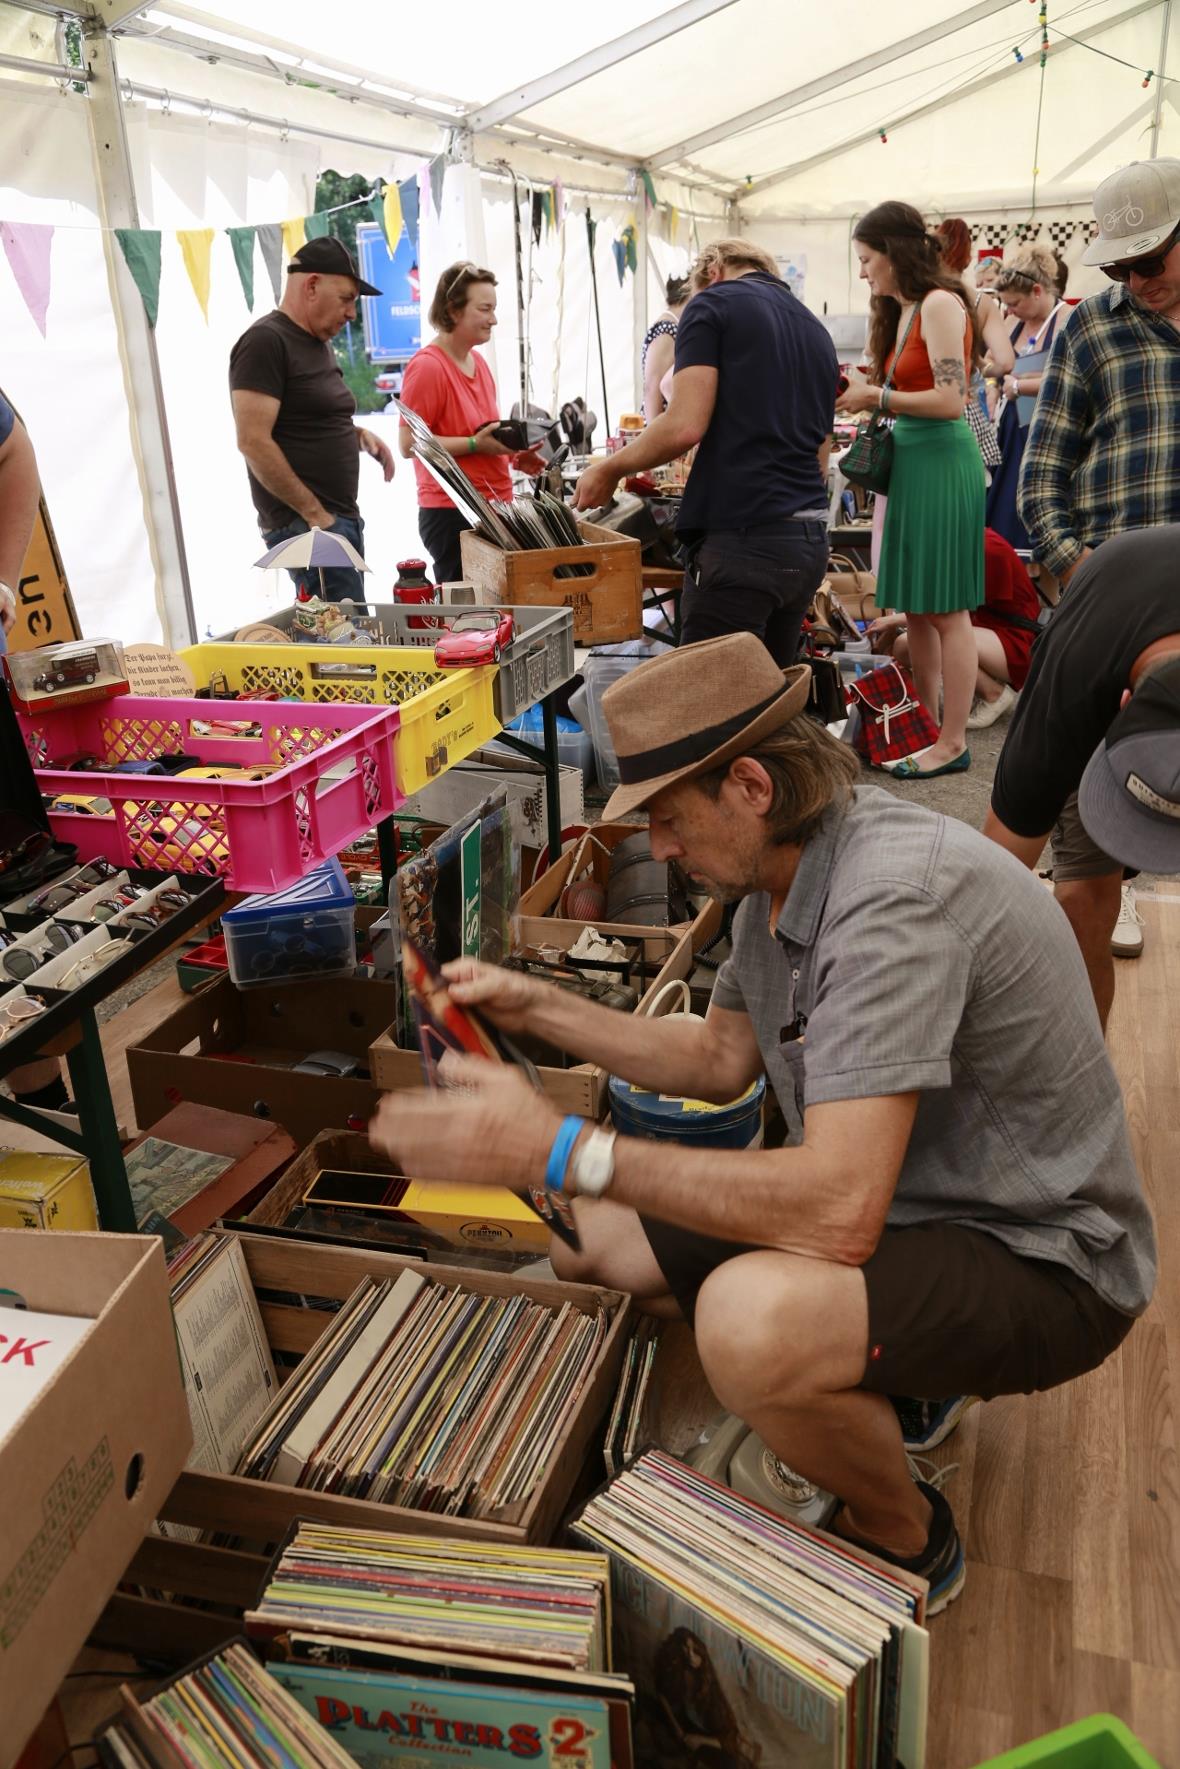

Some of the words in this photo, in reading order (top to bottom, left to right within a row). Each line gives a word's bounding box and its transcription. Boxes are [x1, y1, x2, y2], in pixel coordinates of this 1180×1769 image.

[19, 575, 64, 648] en
[466, 878, 479, 946] ST.
[314, 1695, 544, 1759] PLATTERS
[551, 1718, 588, 1757] 2
[409, 1700, 439, 1716] The
[387, 1735, 473, 1758] Collection
